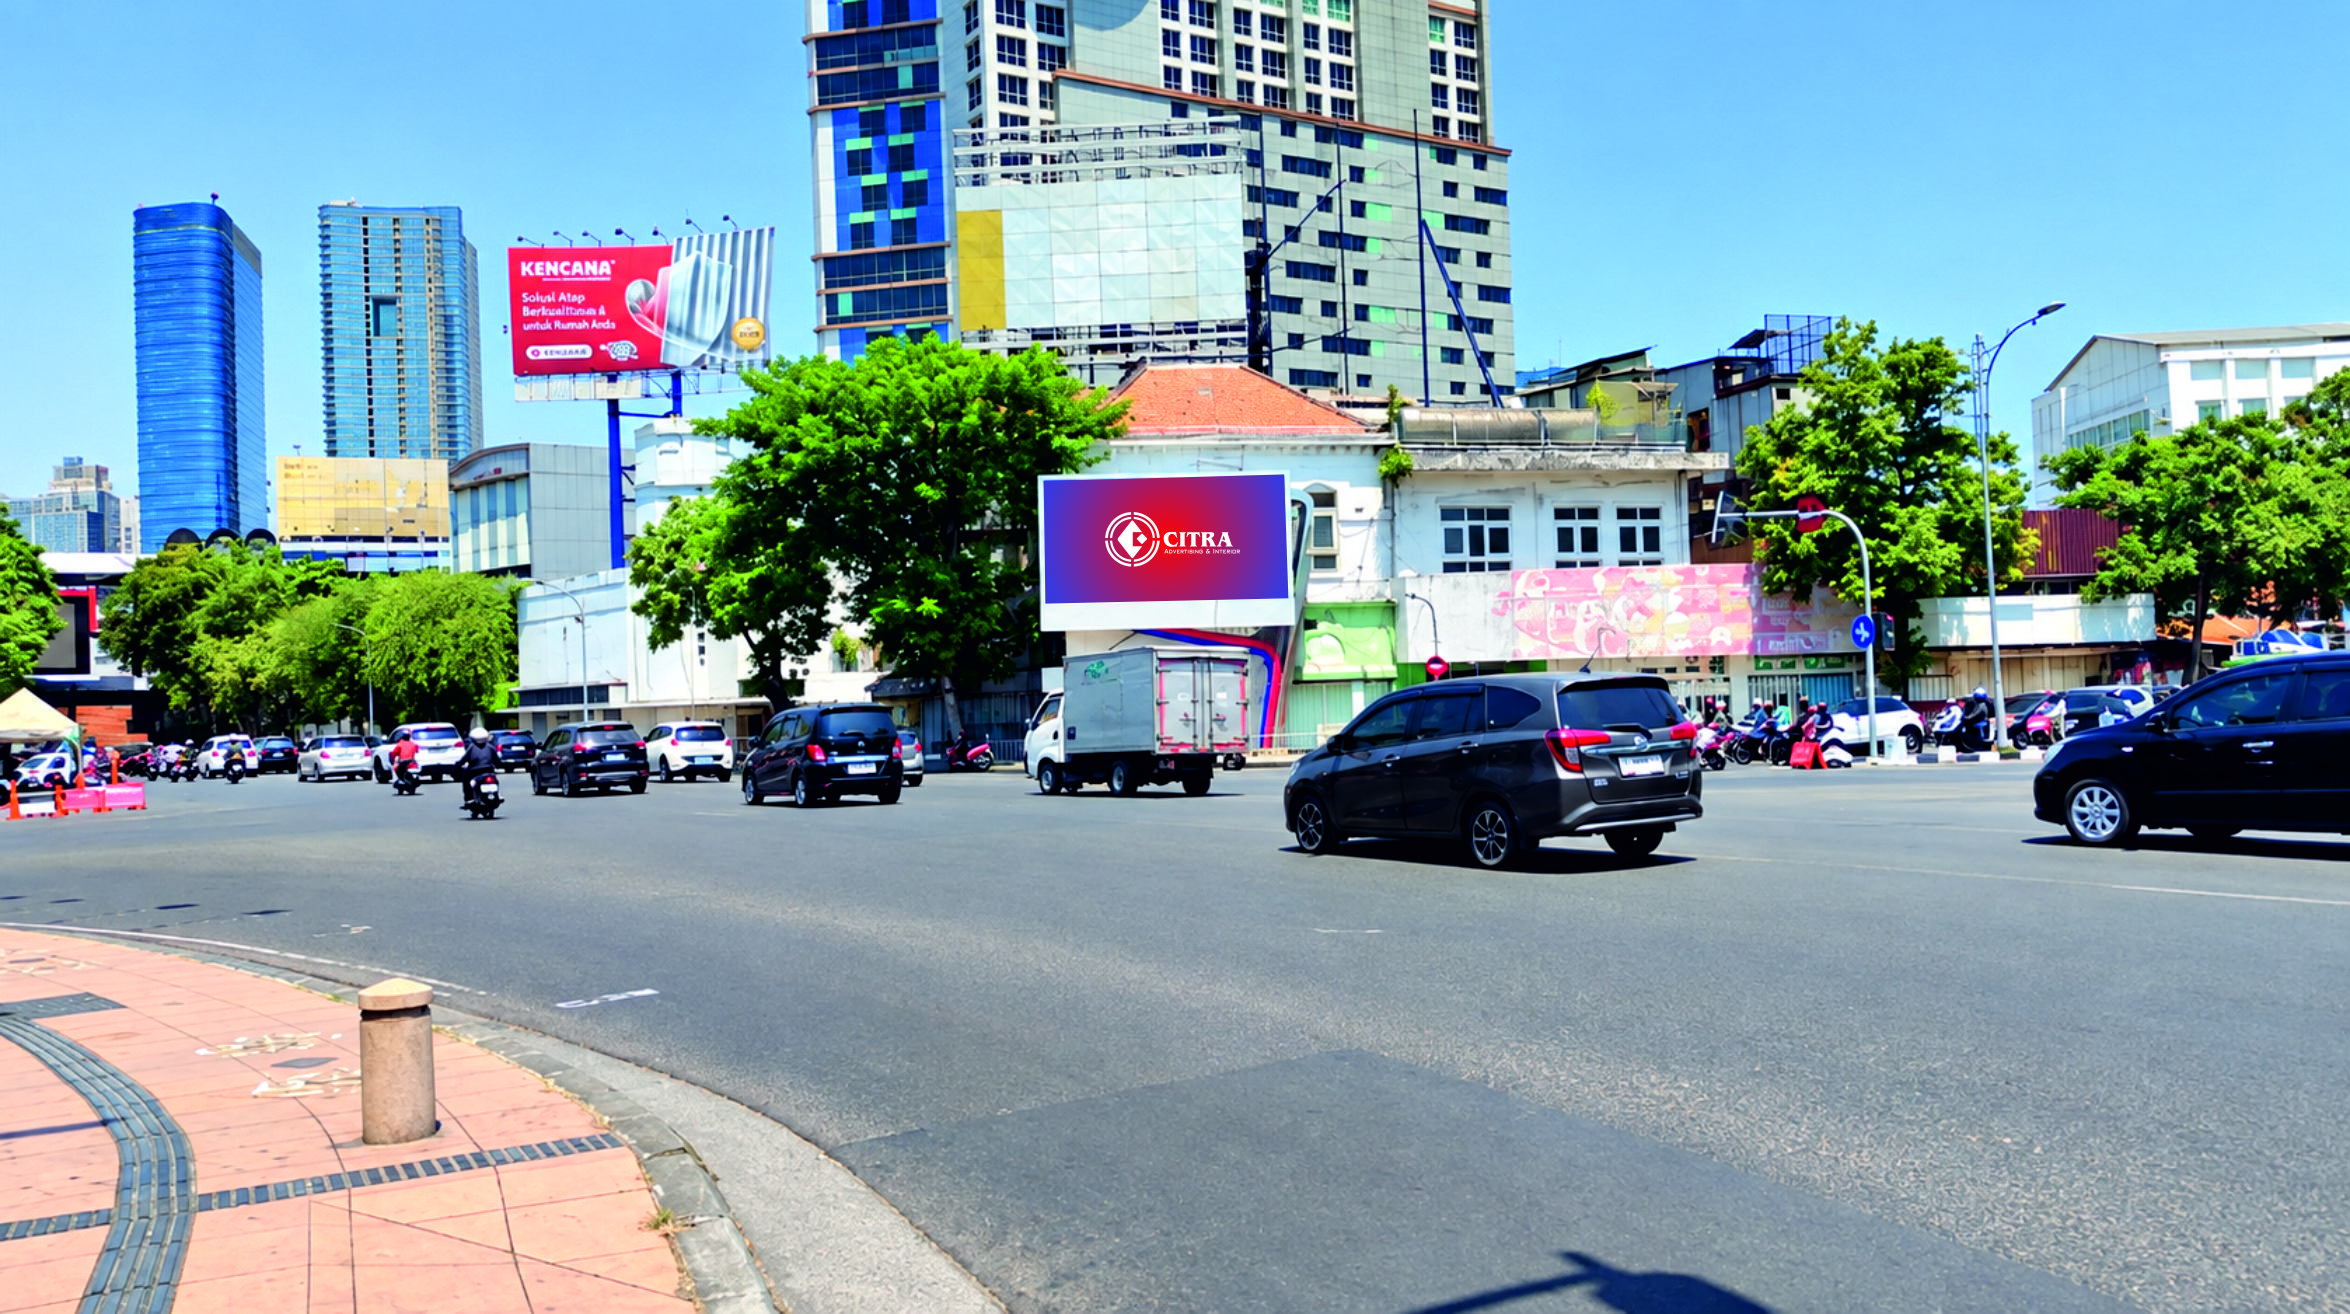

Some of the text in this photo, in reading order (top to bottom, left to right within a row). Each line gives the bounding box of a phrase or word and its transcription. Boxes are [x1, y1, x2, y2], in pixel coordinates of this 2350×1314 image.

[520, 260, 612, 277] KENCANA
[521, 292, 586, 304] Solusi Atap
[523, 318, 616, 331] untuk Rumah Anda
[1163, 531, 1233, 548] CITRA
